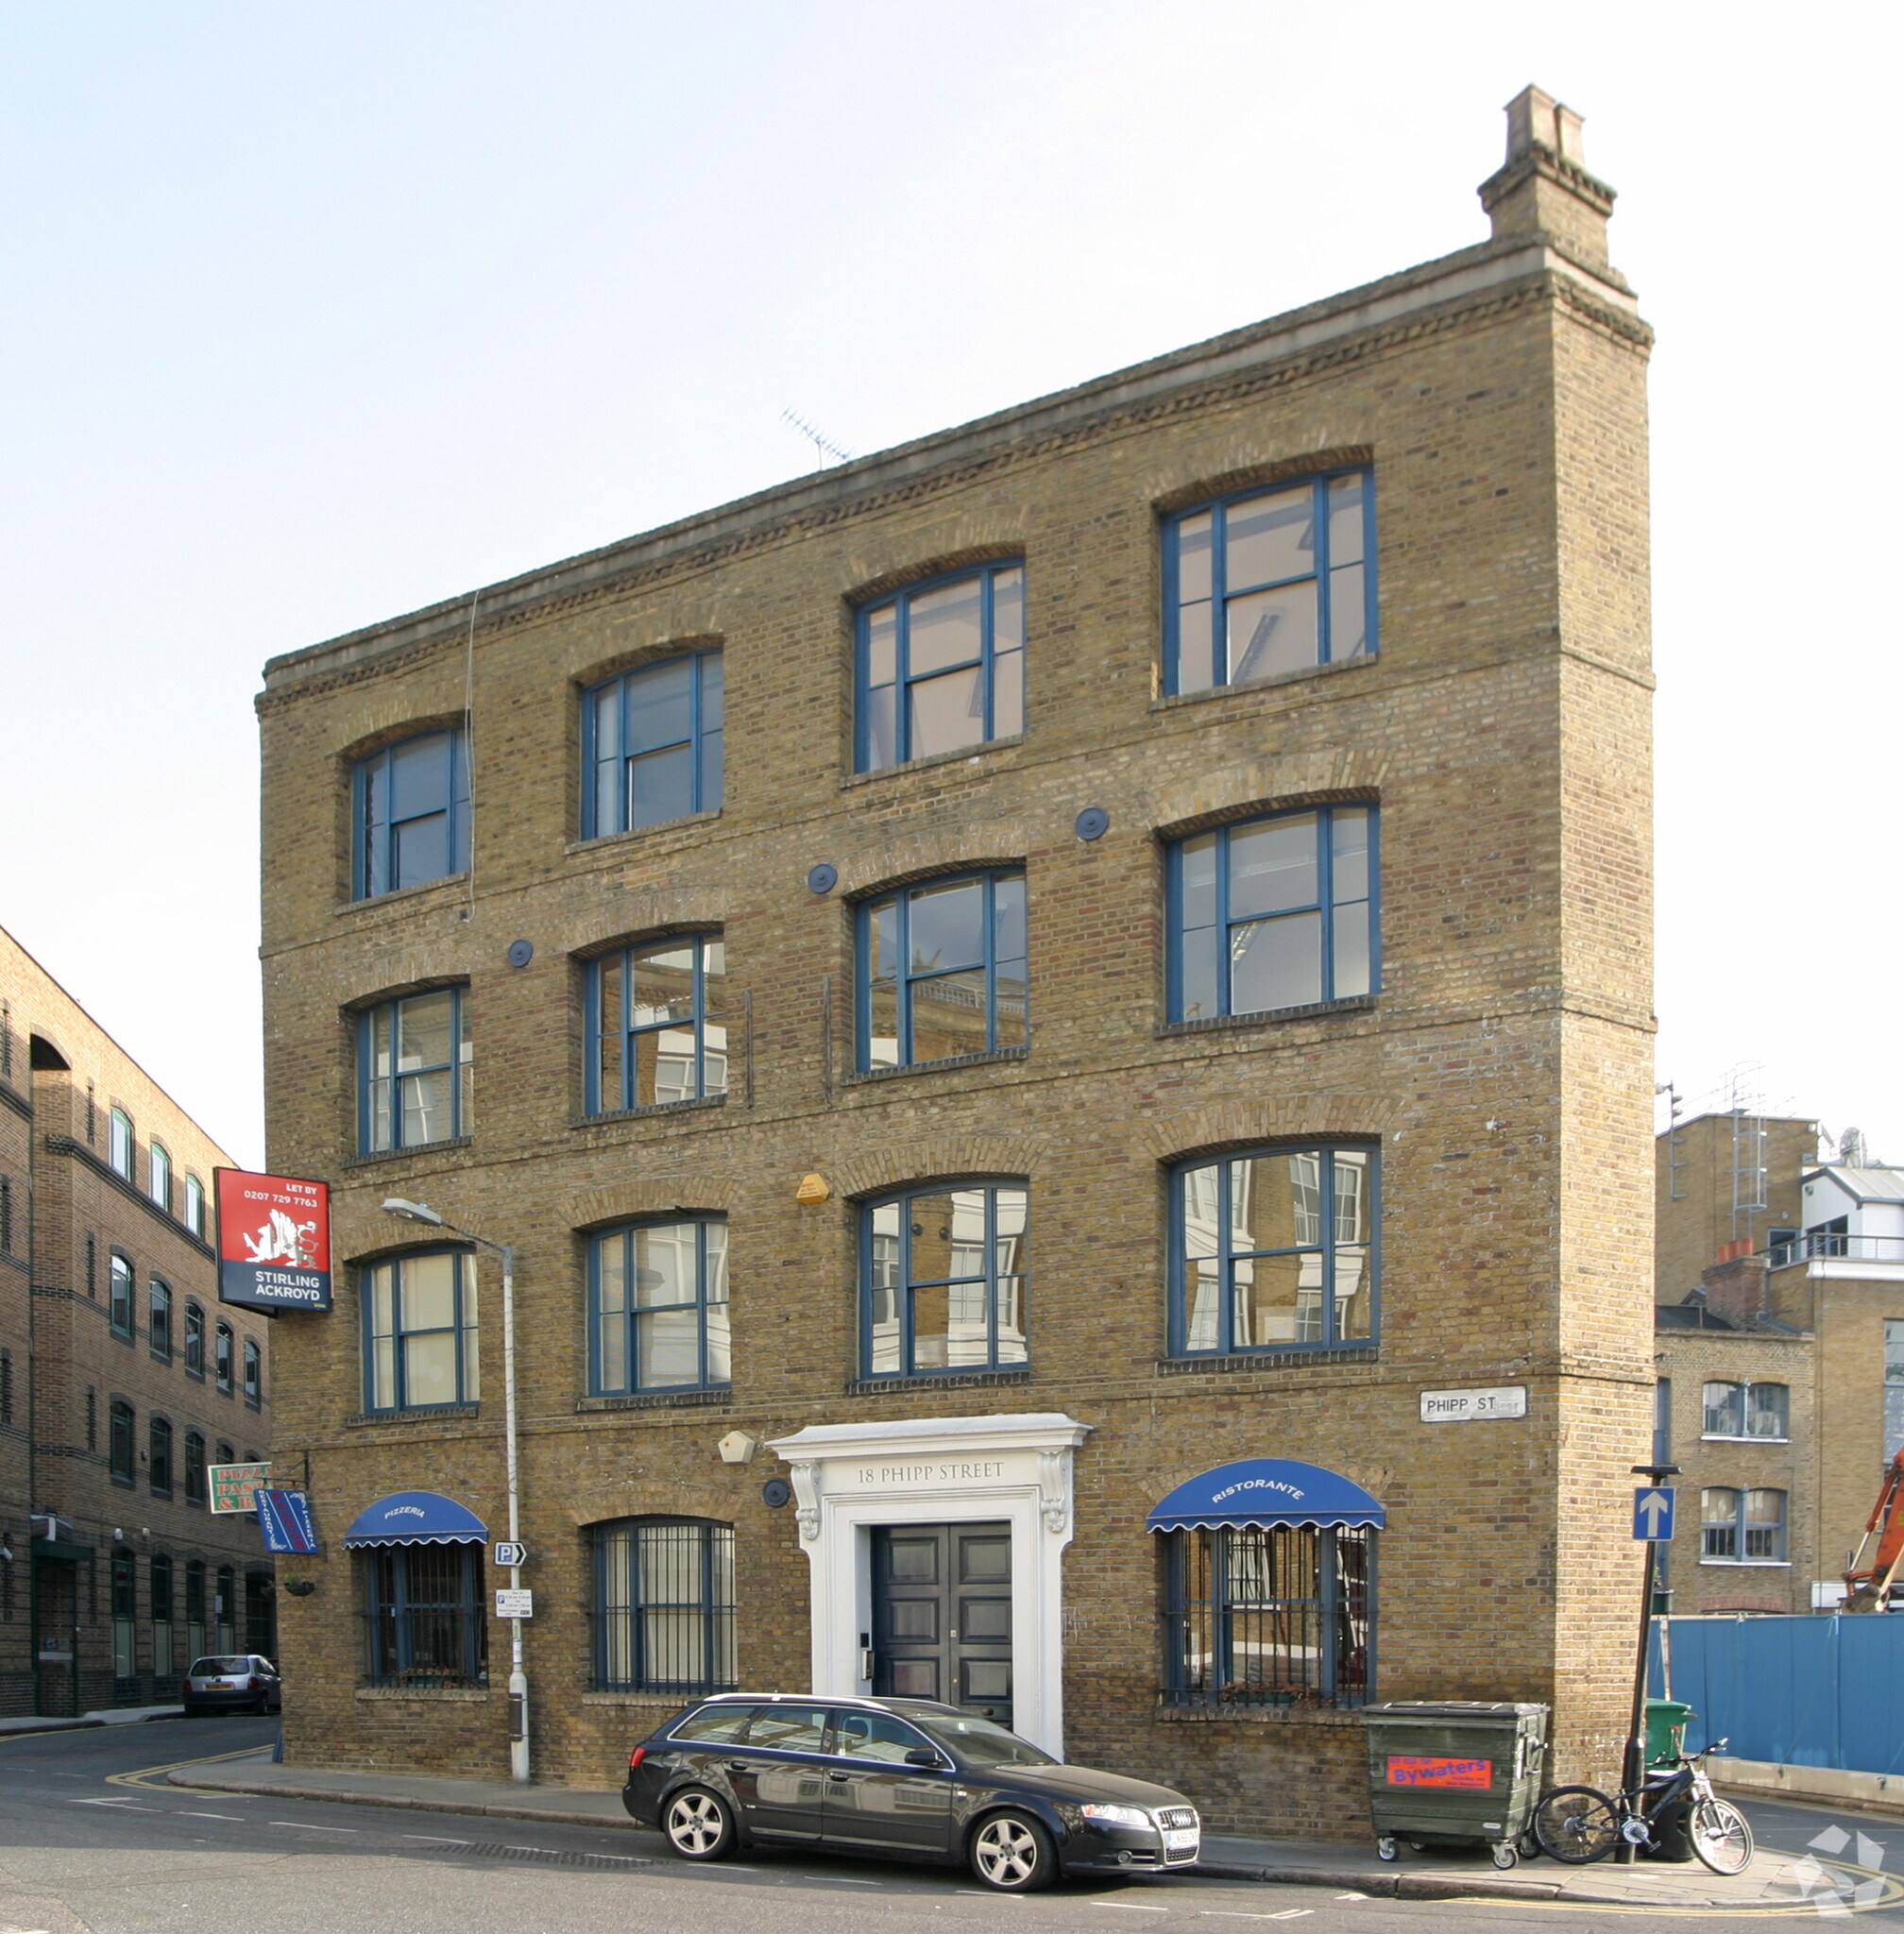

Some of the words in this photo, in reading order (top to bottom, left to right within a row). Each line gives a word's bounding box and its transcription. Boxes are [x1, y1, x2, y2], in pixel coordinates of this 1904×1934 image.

[286, 1183, 303, 1194] LET
[305, 1184, 317, 1196] BY
[244, 1190, 269, 1201] 0207
[272, 1194, 291, 1204] 729
[294, 1196, 318, 1208] 7763
[255, 1270, 320, 1288] STIRLING
[255, 1284, 320, 1301] ACKROYD
[1427, 1398, 1469, 1413] PHIPP
[858, 1468, 875, 1484] 18
[881, 1465, 933, 1483] PHIPP
[939, 1462, 1005, 1480] STREET
[1211, 1479, 1305, 1503] RISTORANTE
[384, 1505, 426, 1519] PIZZERIA
[1393, 1759, 1487, 1784] Bywaters
